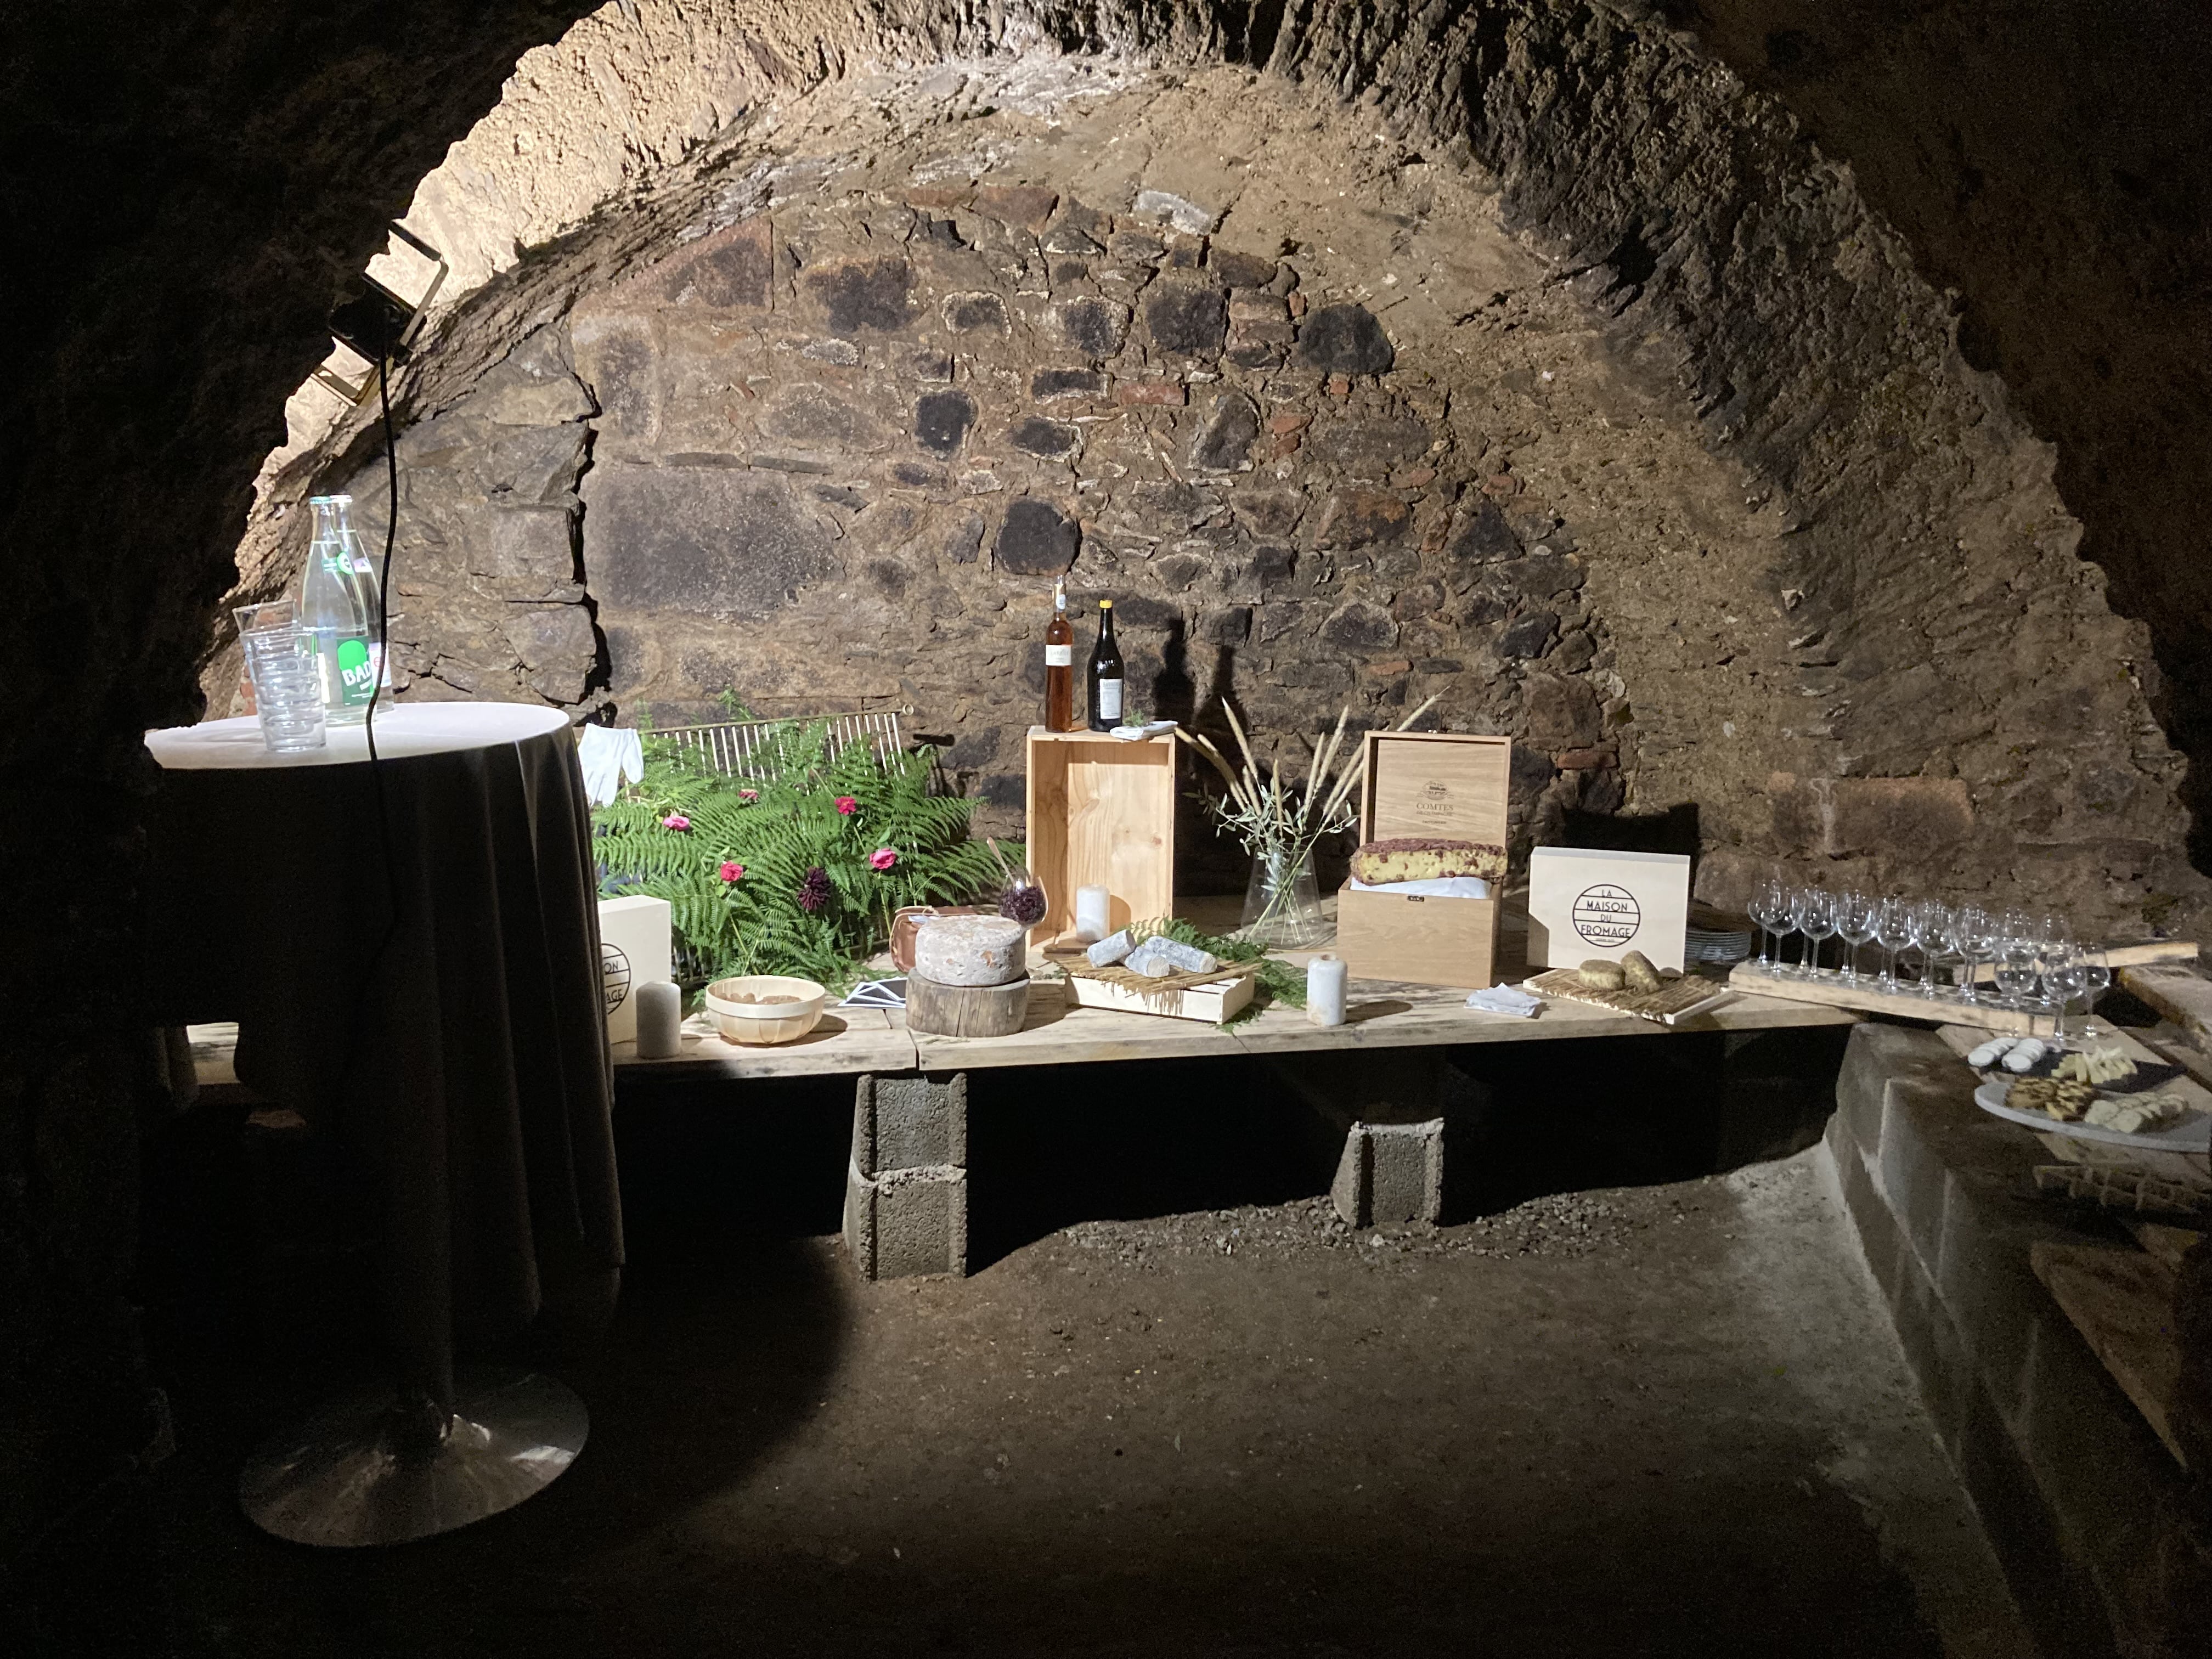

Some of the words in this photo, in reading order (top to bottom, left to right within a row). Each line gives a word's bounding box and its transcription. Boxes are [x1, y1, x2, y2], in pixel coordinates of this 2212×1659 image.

[1416, 803, 1453, 811] COMTES
[1601, 889, 1612, 898] LA
[1587, 900, 1628, 912] MAISON
[1600, 913, 1612, 923] DU
[1581, 924, 1631, 938] FROMAGE
